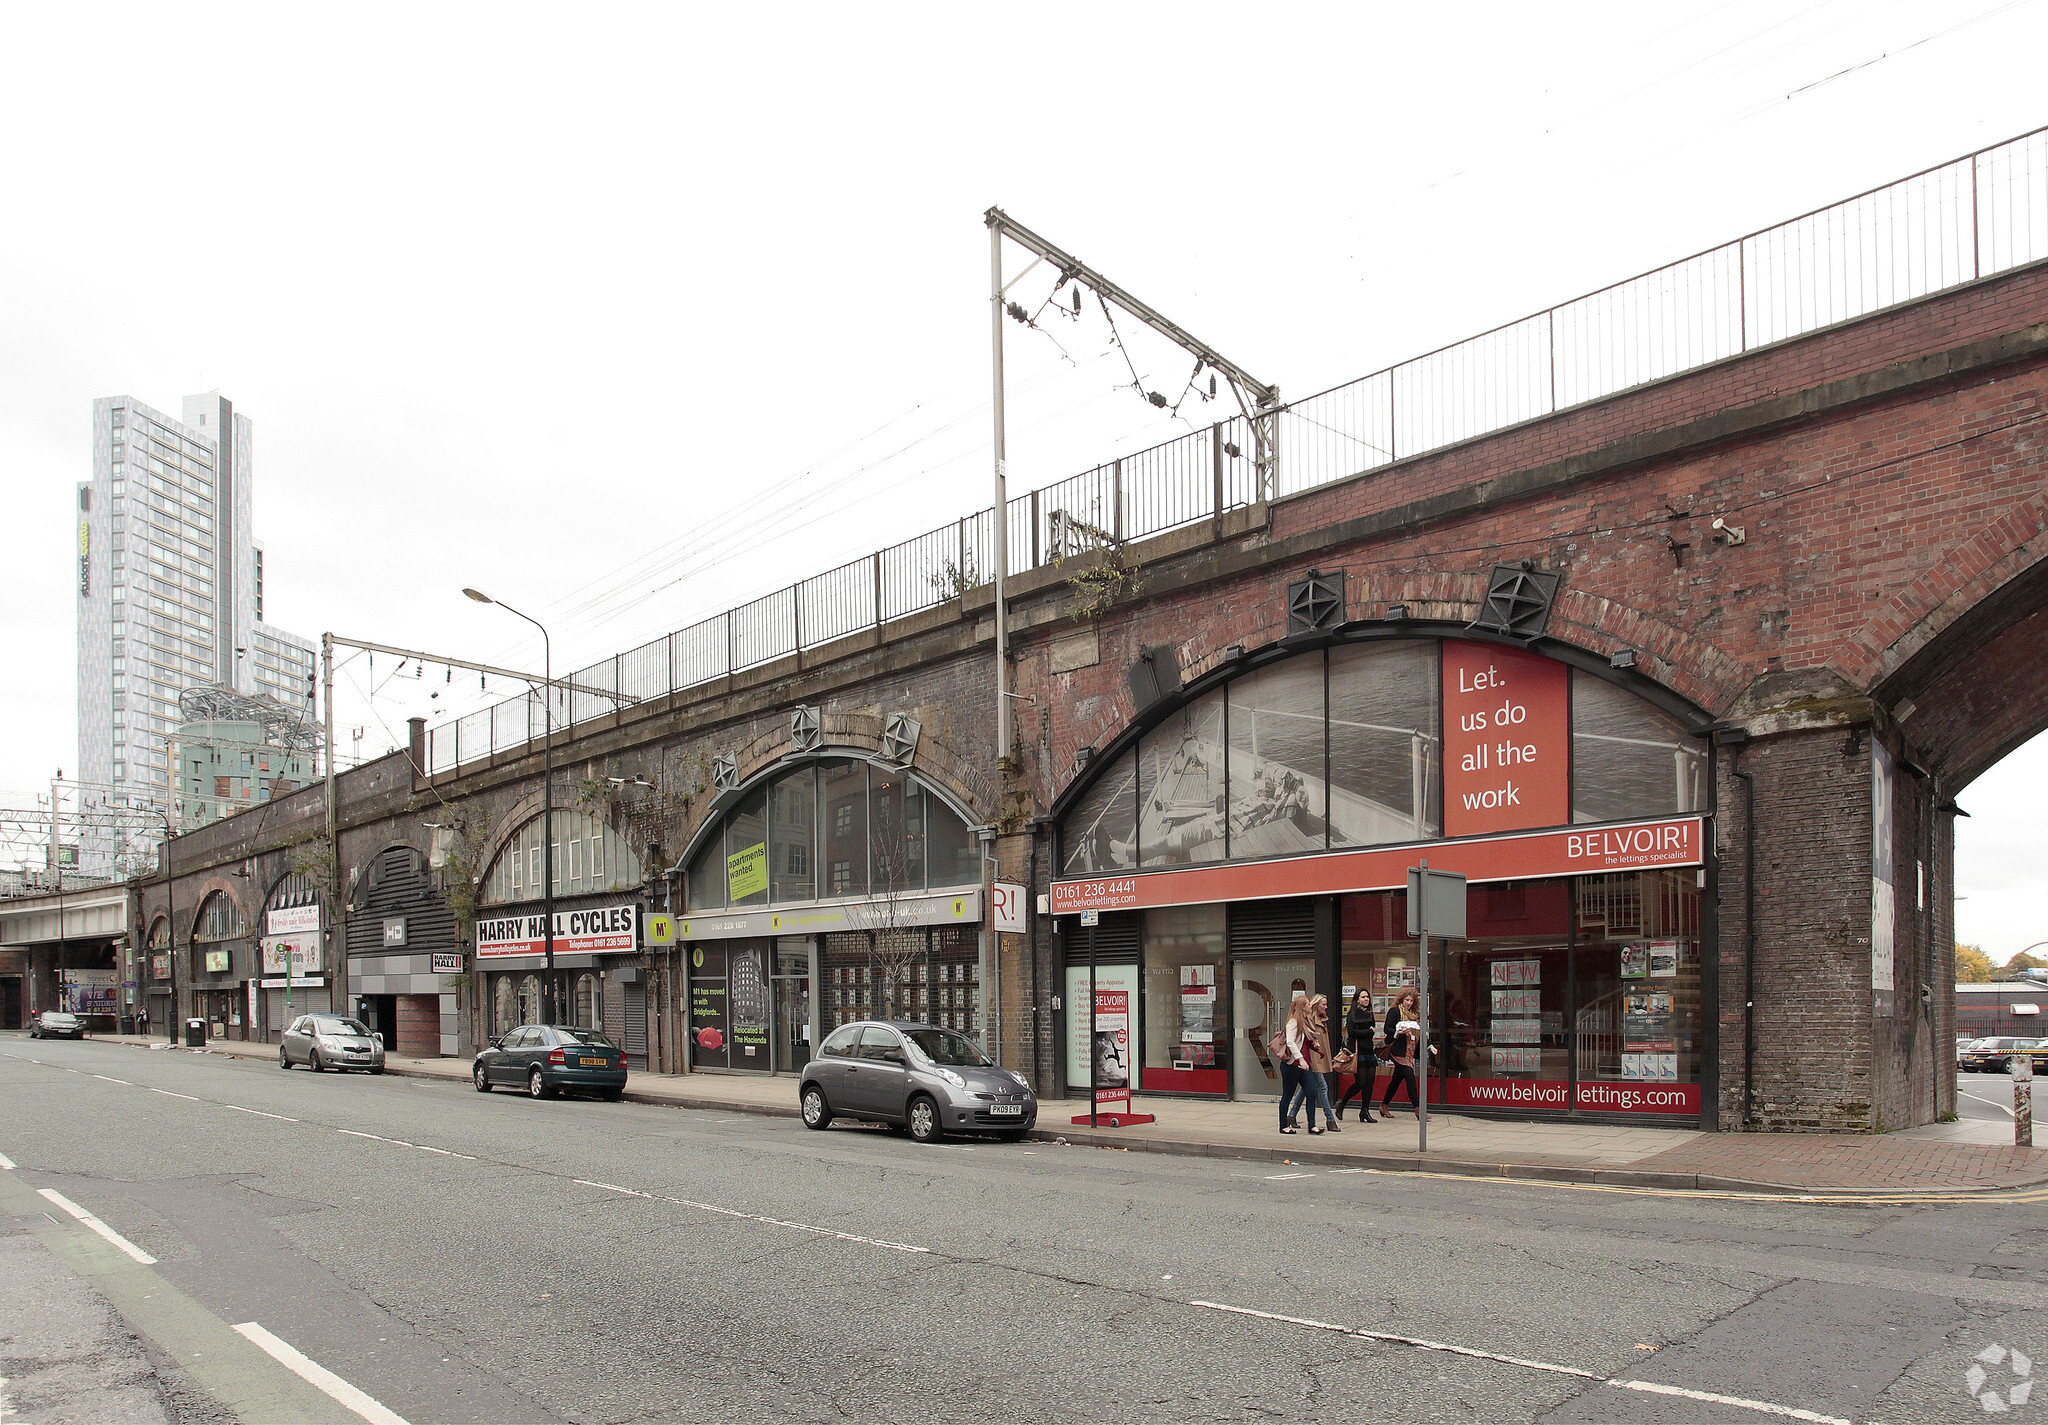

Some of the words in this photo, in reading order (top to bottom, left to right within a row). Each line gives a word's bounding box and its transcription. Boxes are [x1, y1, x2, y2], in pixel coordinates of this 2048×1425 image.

[1459, 664, 1506, 693] Let.
[1461, 711, 1487, 732] us
[1494, 700, 1527, 726] do
[1461, 744, 1488, 771] all
[1496, 740, 1537, 766] the
[1462, 781, 1521, 811] work
[1567, 825, 1688, 858] BELVOIR!
[728, 848, 765, 869] apartments
[1605, 857, 1618, 865] the
[1619, 855, 1649, 864] lettings
[1650, 851, 1687, 861] specialist
[730, 862, 755, 879] wanted.
[1056, 886, 1080, 899] 0161
[1084, 883, 1106, 896] 236
[1108, 880, 1136, 893] 4441
[1057, 895, 1136, 908] www.belvoirlettings.com
[479, 919, 523, 941] HARRY
[526, 911, 565, 938] HAL
[570, 908, 632, 935] CYCLES
[799, 913, 843, 925] apartments
[434, 960, 456, 968] HALL
[1494, 964, 1538, 982] NEW
[1494, 996, 1538, 1008] HOMES
[1494, 1024, 1538, 1038] LISTED
[1494, 1052, 1538, 1068] DAILY
